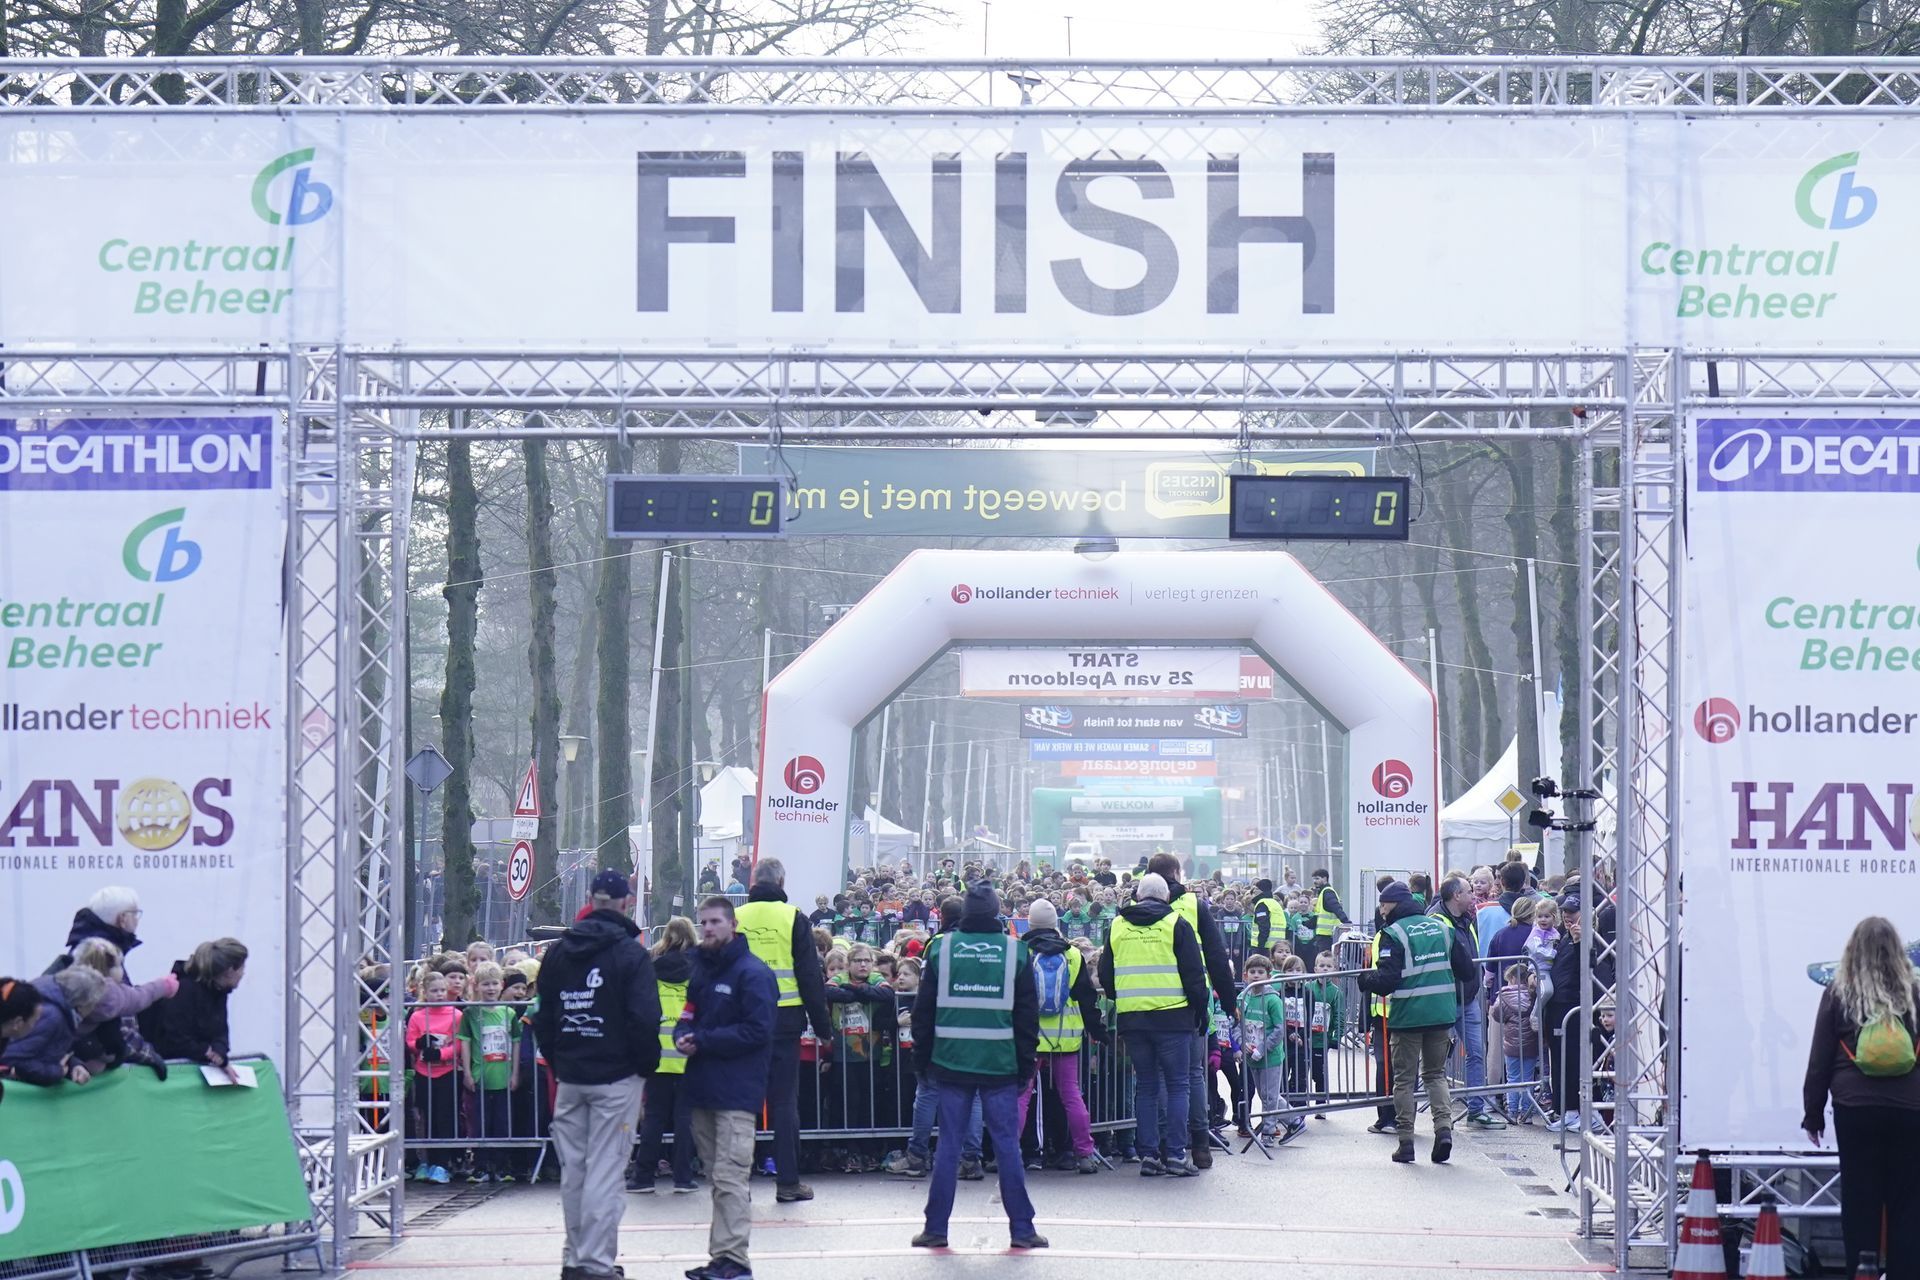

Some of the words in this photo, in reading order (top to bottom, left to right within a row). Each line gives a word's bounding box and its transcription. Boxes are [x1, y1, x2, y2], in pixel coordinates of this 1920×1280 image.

[636, 149, 1335, 316] FINISH
[98, 237, 295, 272] Centraal
[1641, 241, 1840, 276] Centraal
[134, 280, 294, 314] Beheer
[1677, 284, 1838, 319] Beheer
[0, 434, 261, 474] DECATHLON
[975, 586, 1052, 600] hollander
[1054, 586, 1119, 600] techniek
[1145, 586, 1196, 601] verlegt
[1200, 587, 1259, 601] grenzen
[0, 593, 165, 628] entraal
[1765, 597, 1920, 630] Centra
[7, 635, 163, 669] Beheer
[129, 702, 271, 731] techniek
[1749, 705, 1917, 734] hollander
[0, 777, 234, 851] ANOS
[769, 795, 839, 811] hollander
[774, 811, 829, 824] techniek
[1101, 800, 1154, 810] WELKOM
[1357, 801, 1428, 815] hollander
[1731, 782, 1920, 850] HAN
[1365, 815, 1420, 826] techniek
[0, 856, 58, 870] TIONALE
[68, 856, 124, 869] HORECA
[134, 855, 234, 869] GROOTHANDEL
[512, 858, 528, 881] 30
[1730, 858, 1850, 873] INTERNATIONALE
[1860, 859, 1917, 874] HORECA
